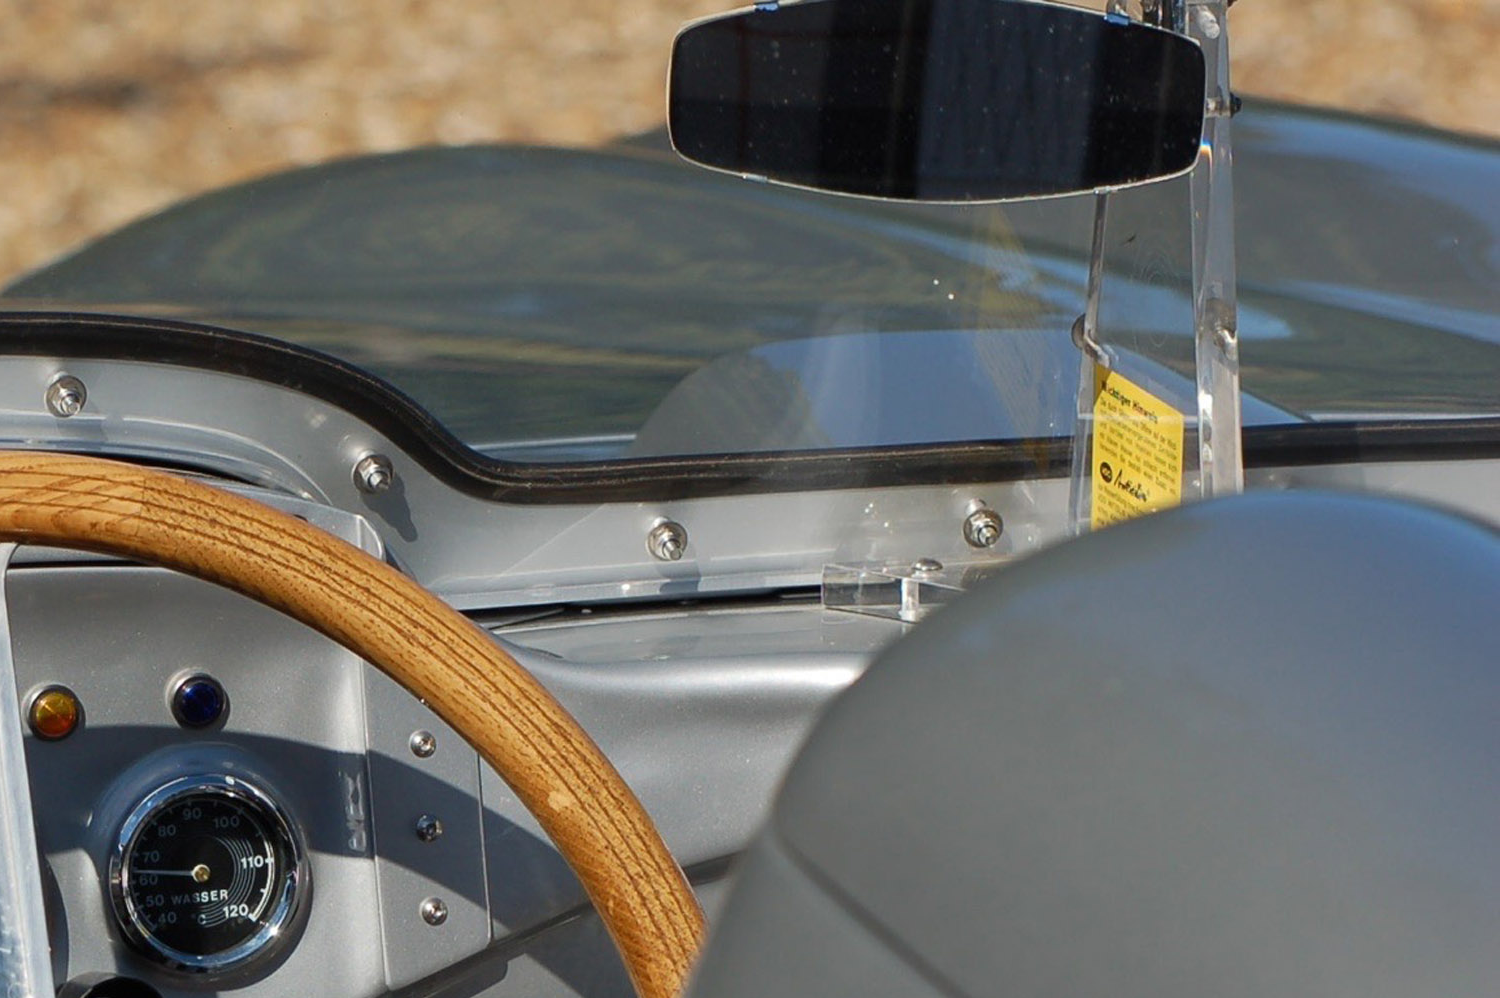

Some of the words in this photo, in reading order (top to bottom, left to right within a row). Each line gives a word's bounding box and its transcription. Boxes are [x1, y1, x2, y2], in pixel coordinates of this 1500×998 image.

[182, 807, 202, 819] 90
[214, 815, 240, 828] 100
[158, 823, 177, 836] 80
[144, 851, 160, 863] 70
[240, 856, 263, 869] 110
[138, 874, 158, 886] 60
[145, 894, 165, 906] 50
[171, 889, 229, 903] WASSER
[158, 911, 177, 923] 40
[222, 904, 249, 919] 120
